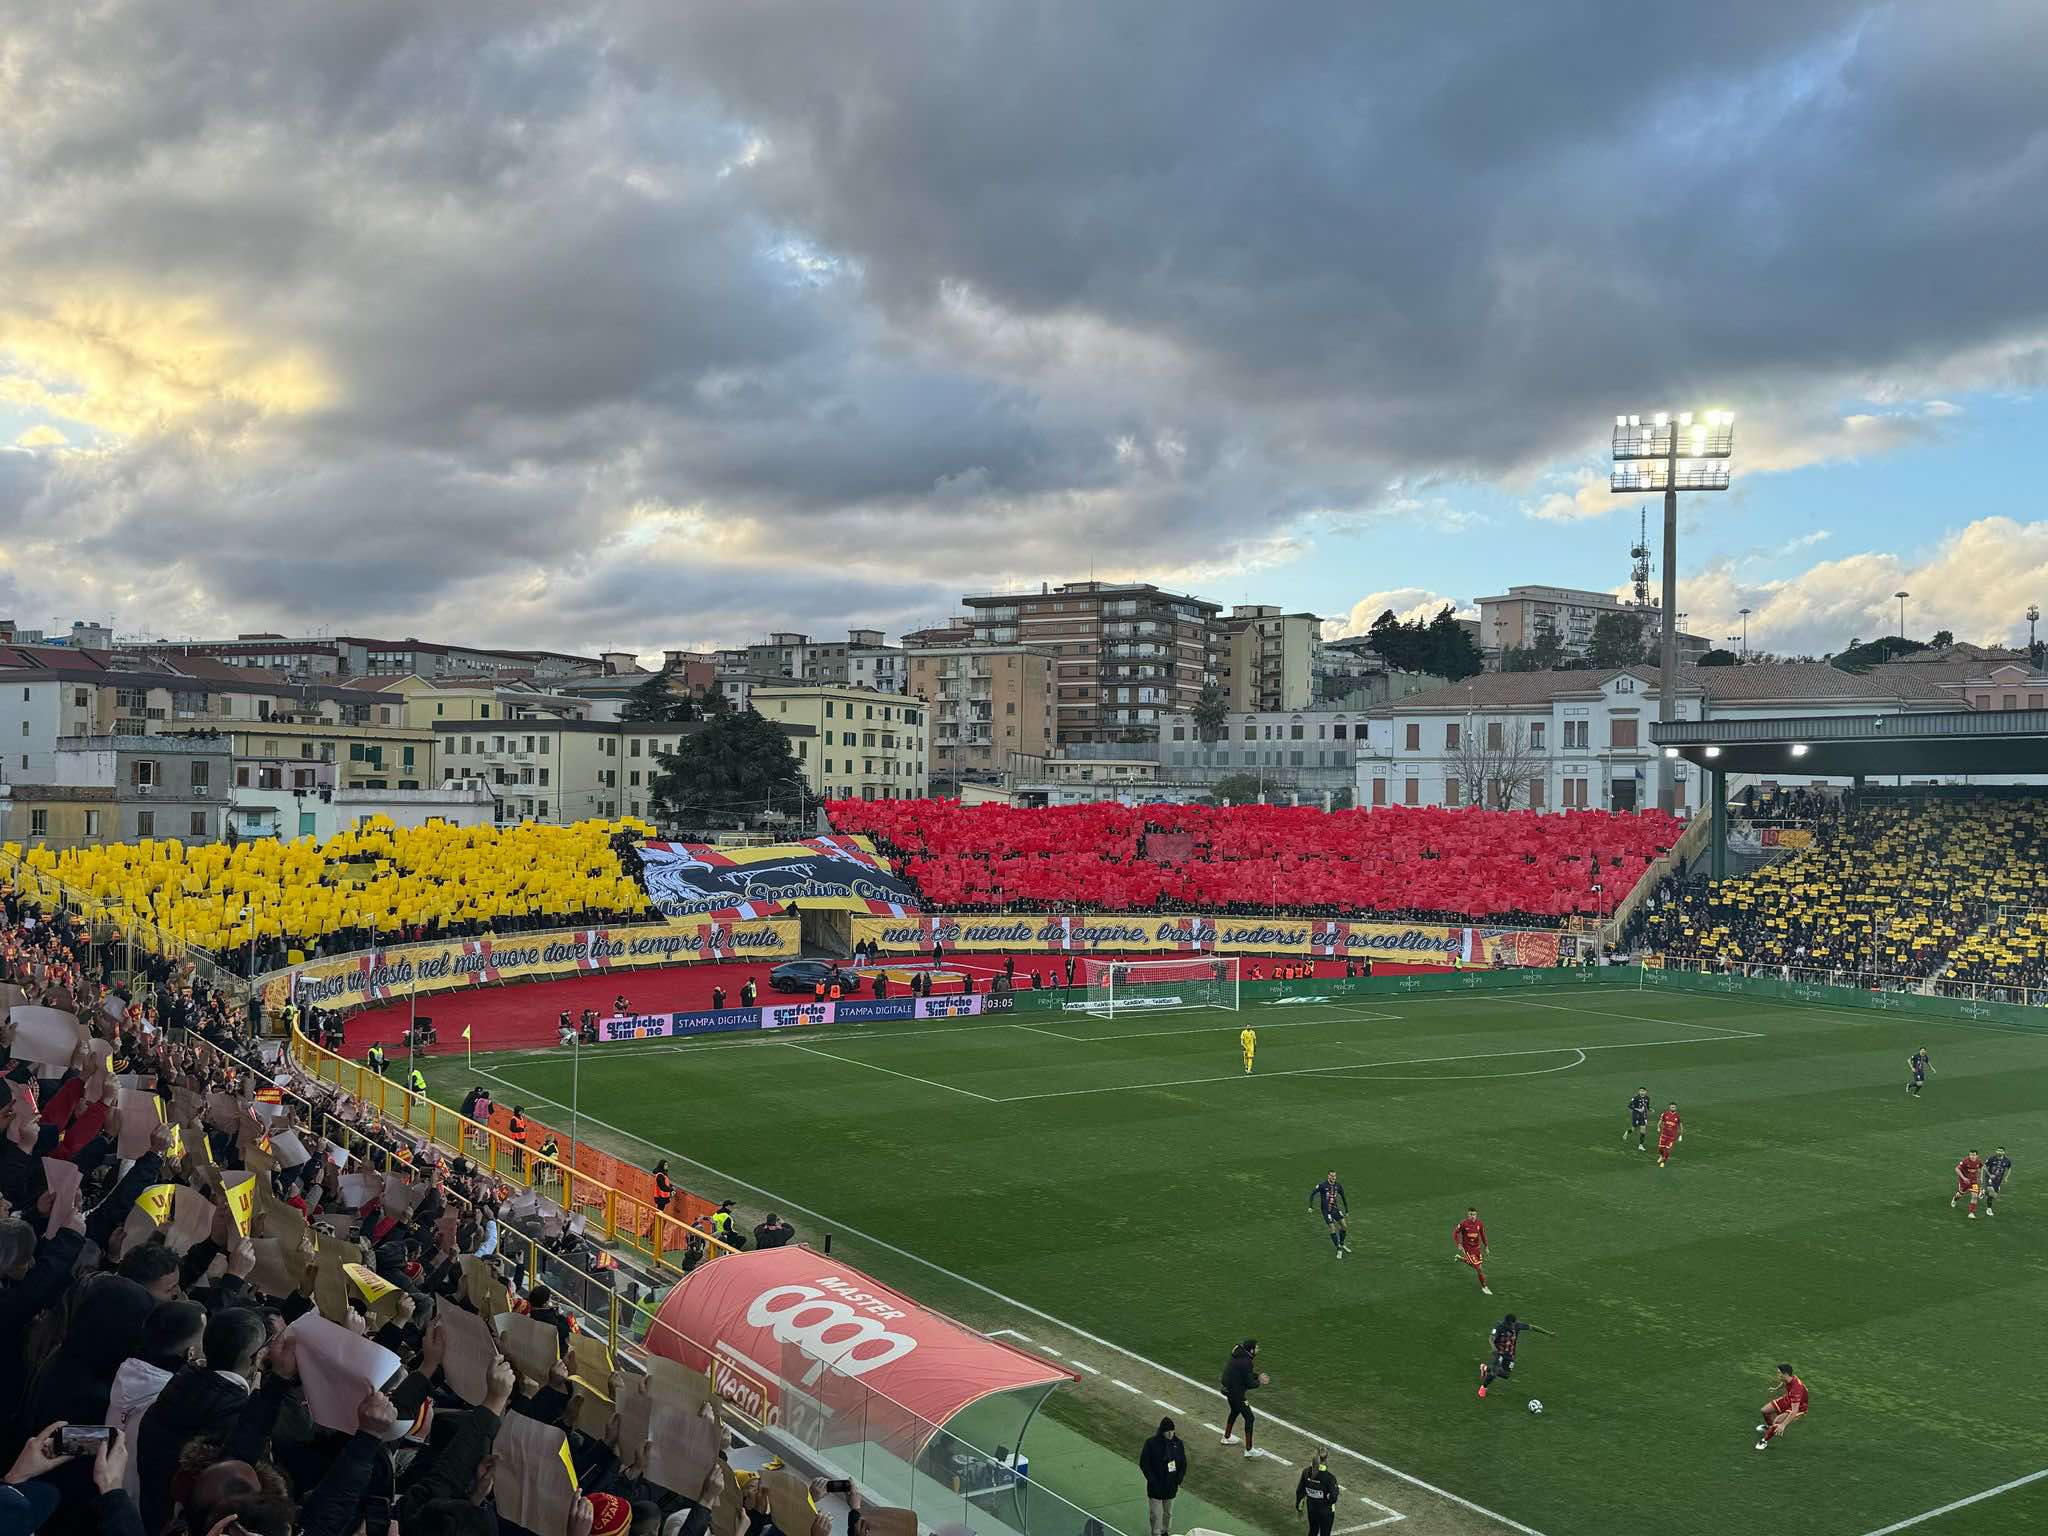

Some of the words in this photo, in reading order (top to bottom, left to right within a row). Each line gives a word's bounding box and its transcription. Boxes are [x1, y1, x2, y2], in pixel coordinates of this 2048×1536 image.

[653, 895, 745, 918] Unione
[746, 879, 850, 905] Sportiva
[881, 925, 926, 943] non
[963, 920, 1033, 943] niente
[1036, 922, 1068, 942] da
[1071, 924, 1149, 947] capire,
[1156, 922, 1218, 943] basta
[1222, 923, 1309, 945] sedersi
[1310, 927, 1341, 948] ed
[1344, 927, 1464, 952] ascoltare!
[294, 971, 345, 1003] Cosco
[346, 969, 367, 993] un
[369, 955, 414, 998] posto
[418, 949, 451, 979] nel
[453, 952, 486, 975] mio
[490, 945, 540, 968] cuore
[543, 939, 588, 963] dove
[590, 935, 625, 958] tira
[628, 934, 704, 960] sempre
[707, 928, 725, 950] il
[728, 926, 785, 950] vento,
[840, 1007, 873, 1016] STAMPA
[875, 1005, 912, 1015] DIGITALE
[987, 998, 1013, 1008] 03:05
[774, 1004, 826, 1019] grafiche
[607, 1016, 665, 1032] grafiche
[679, 1017, 714, 1028] STAMPA
[718, 1014, 758, 1025] DIGITALE
[816, 1276, 906, 1320] MASTER
